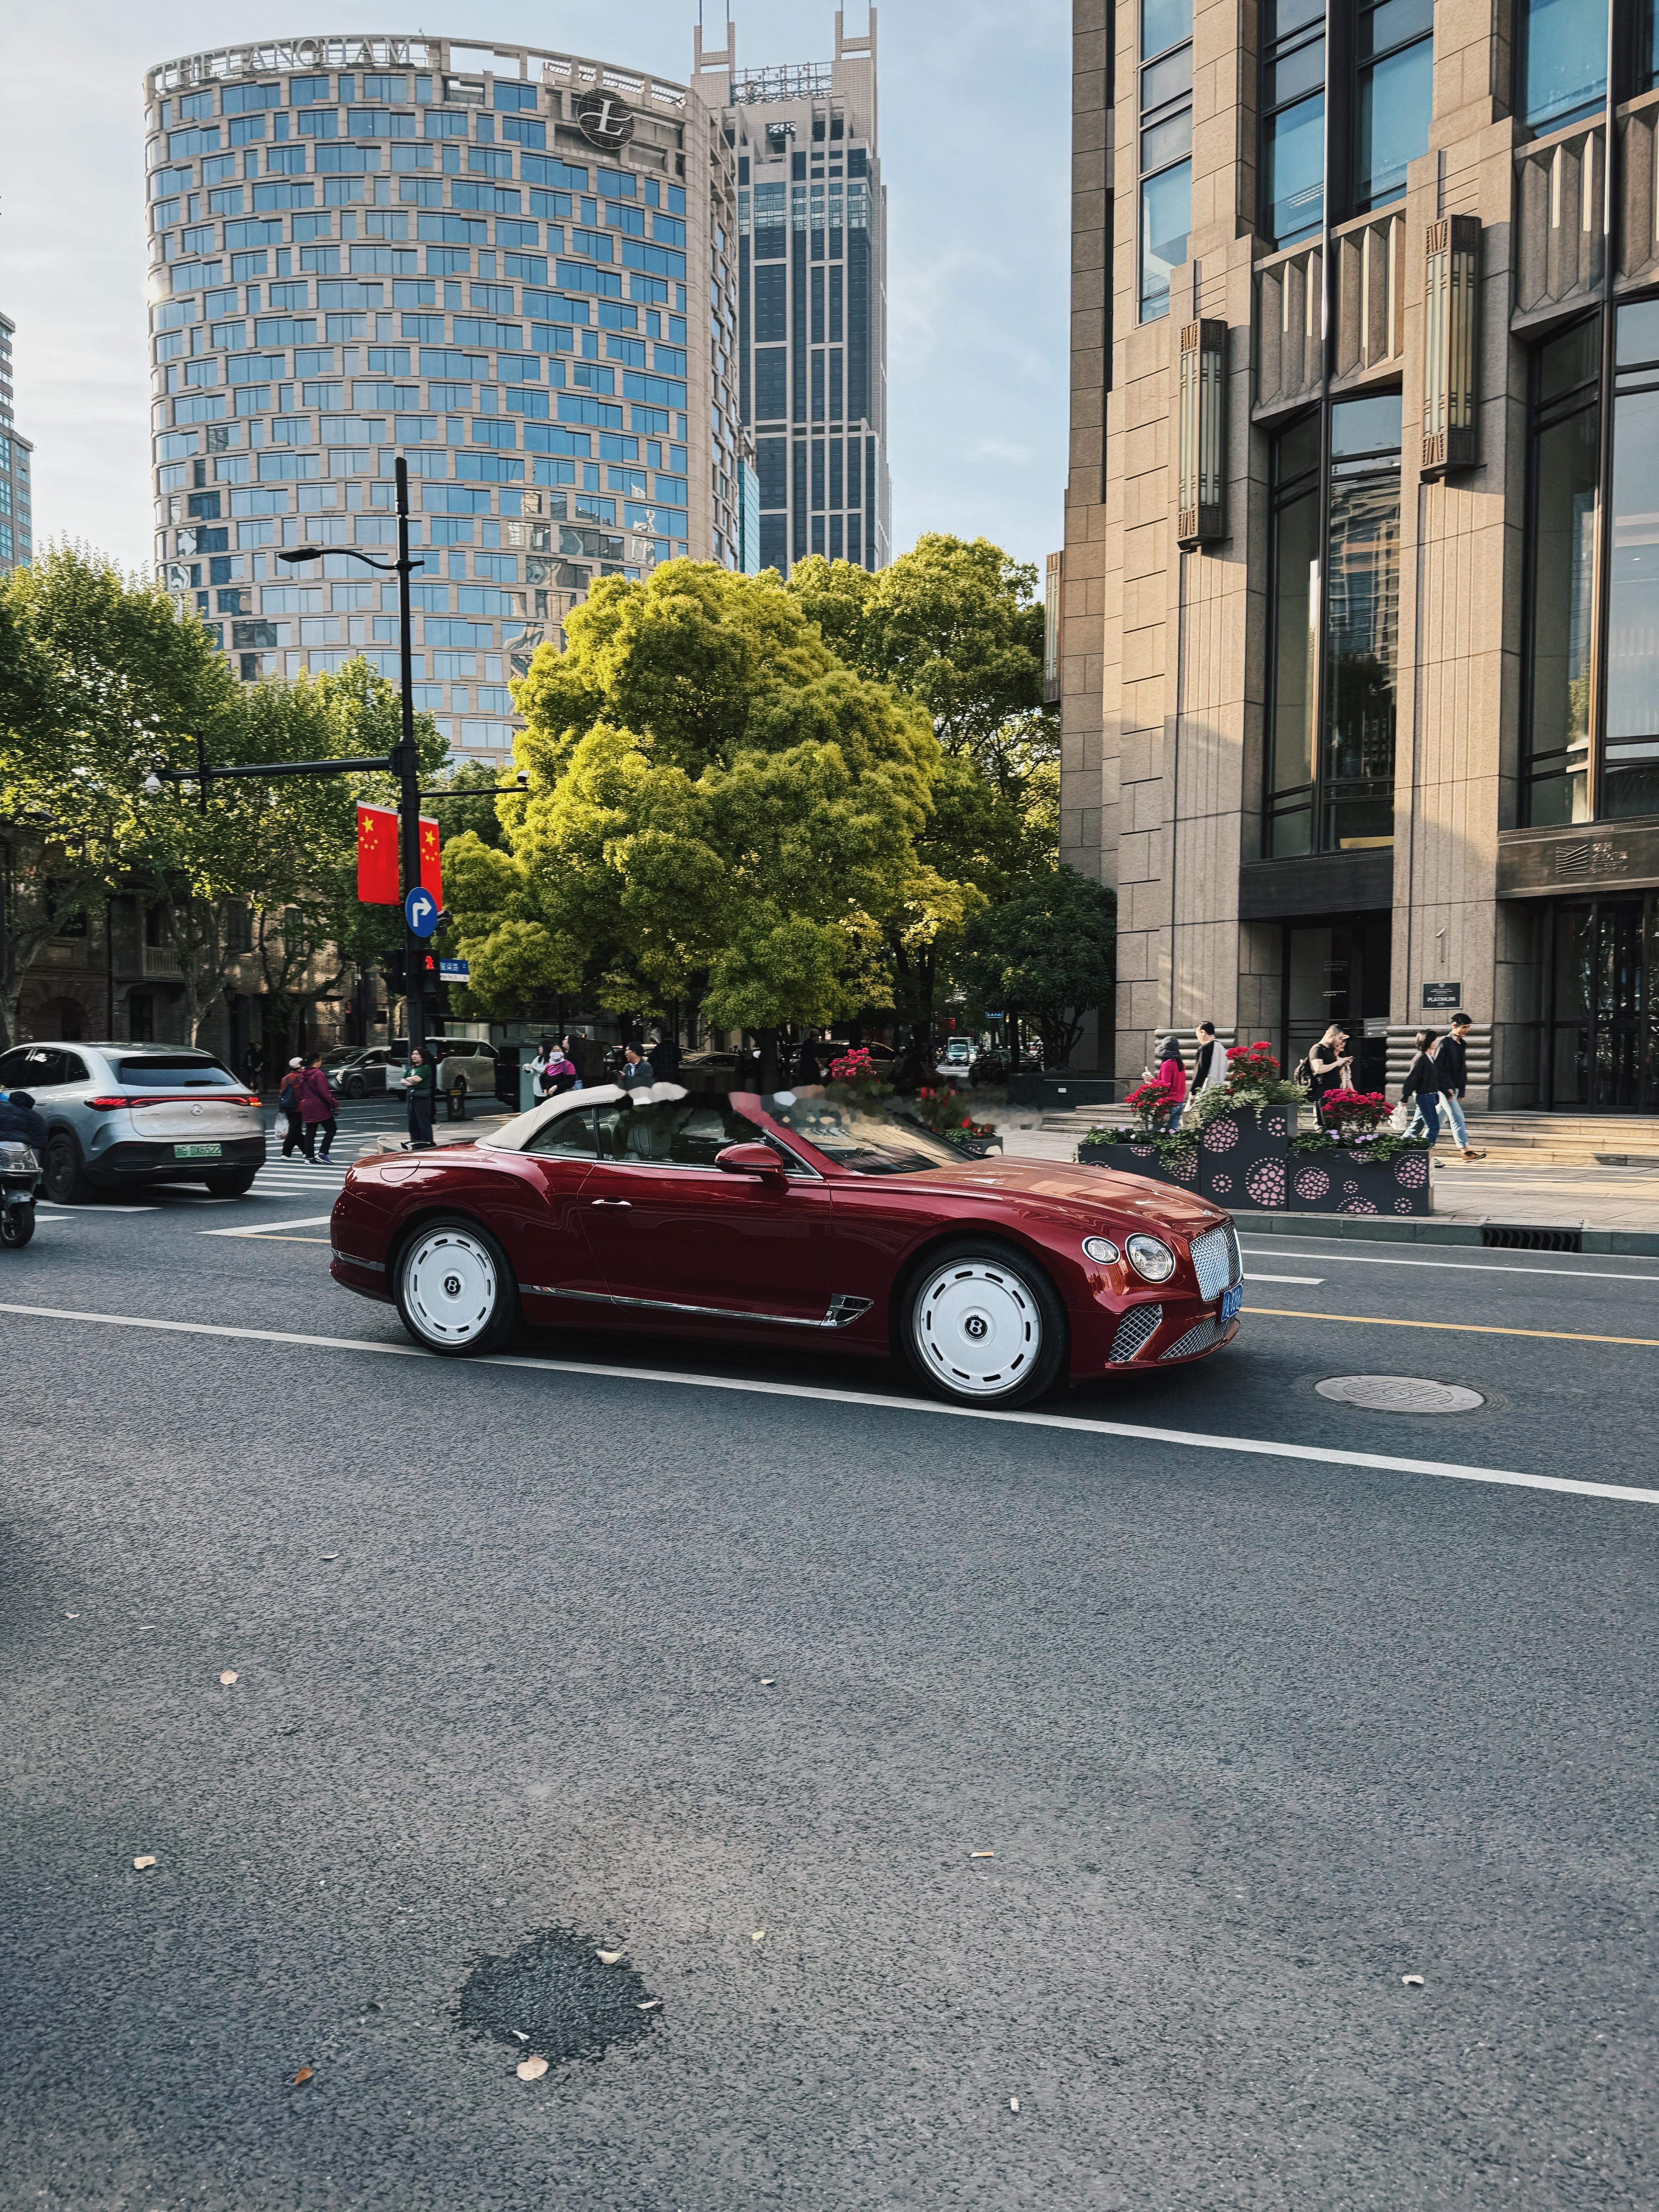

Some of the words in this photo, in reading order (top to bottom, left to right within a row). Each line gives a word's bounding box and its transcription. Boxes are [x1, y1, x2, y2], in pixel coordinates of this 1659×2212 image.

[156, 53, 215, 89] THE
[222, 38, 415, 75] LANGHAM
[447, 1279, 457, 1292] B
[969, 1319, 982, 1334] B
